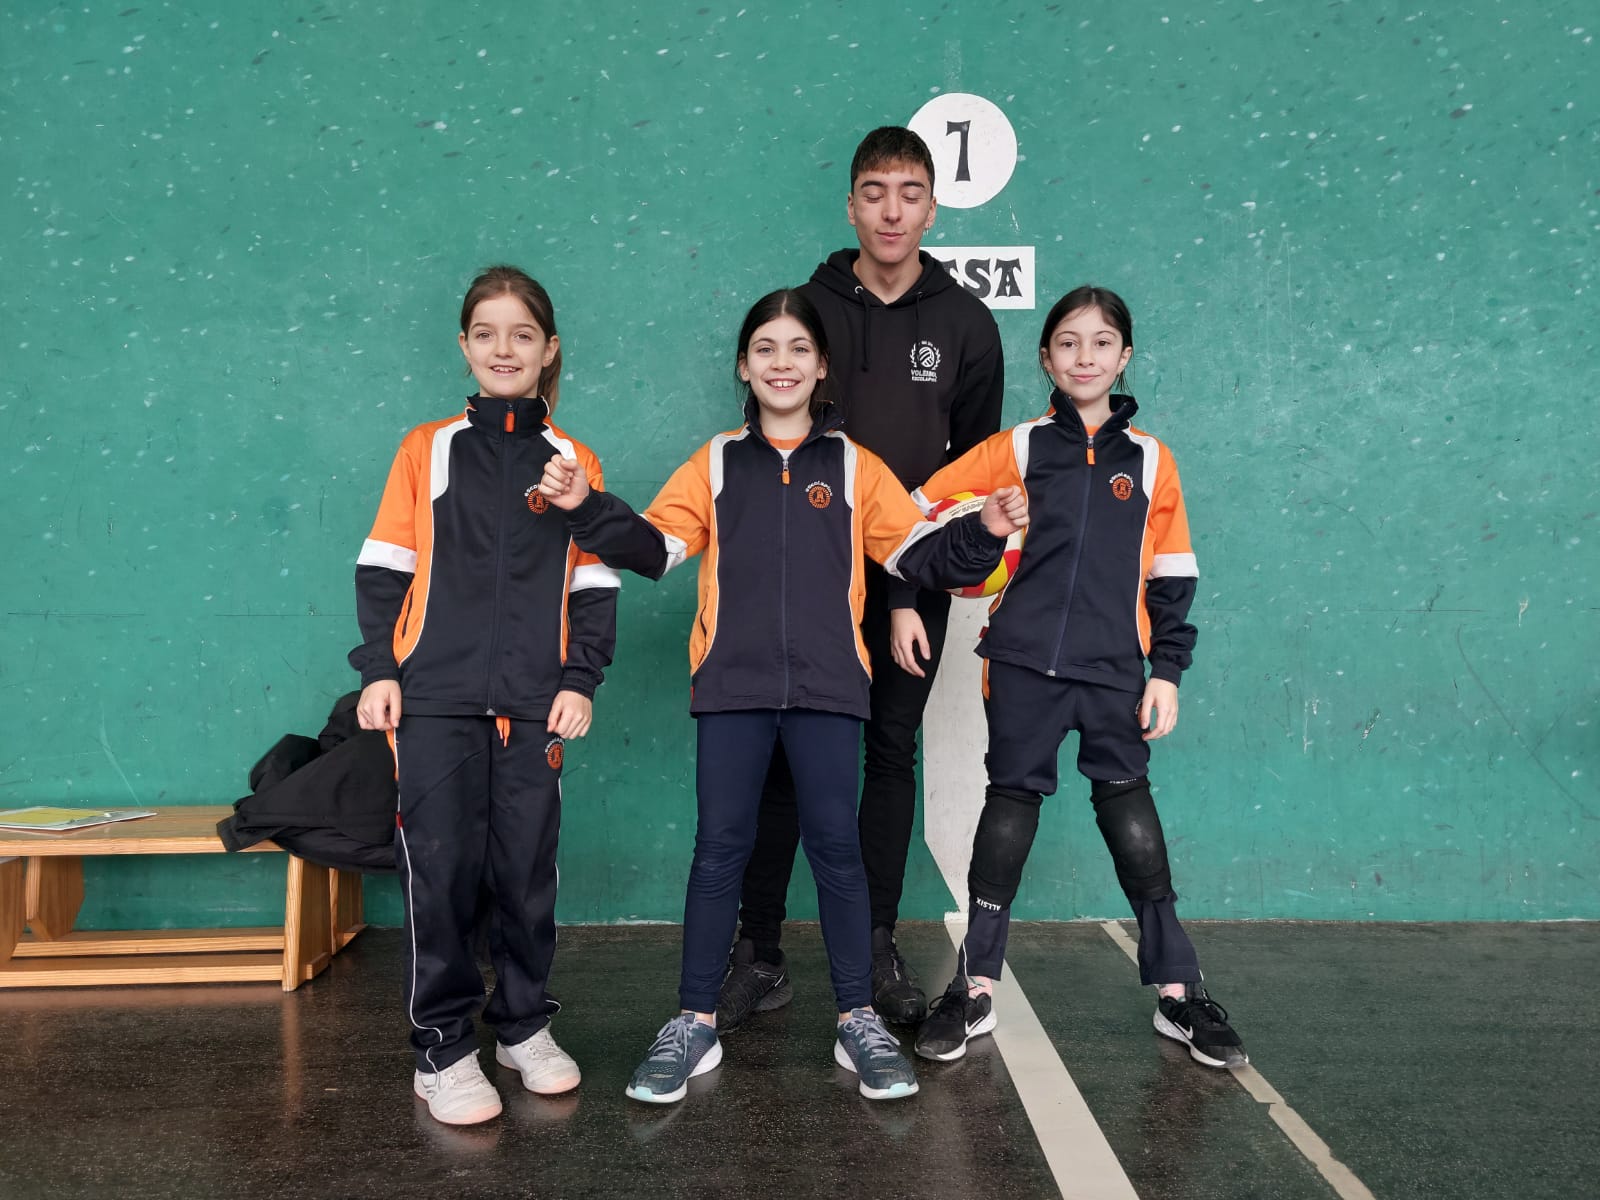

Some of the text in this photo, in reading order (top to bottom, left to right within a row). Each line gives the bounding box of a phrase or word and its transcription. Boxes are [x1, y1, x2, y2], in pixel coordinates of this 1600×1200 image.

[946, 120, 971, 182] 7
[942, 257, 1023, 298] SA
[976, 896, 1002, 911] ALLSIX
